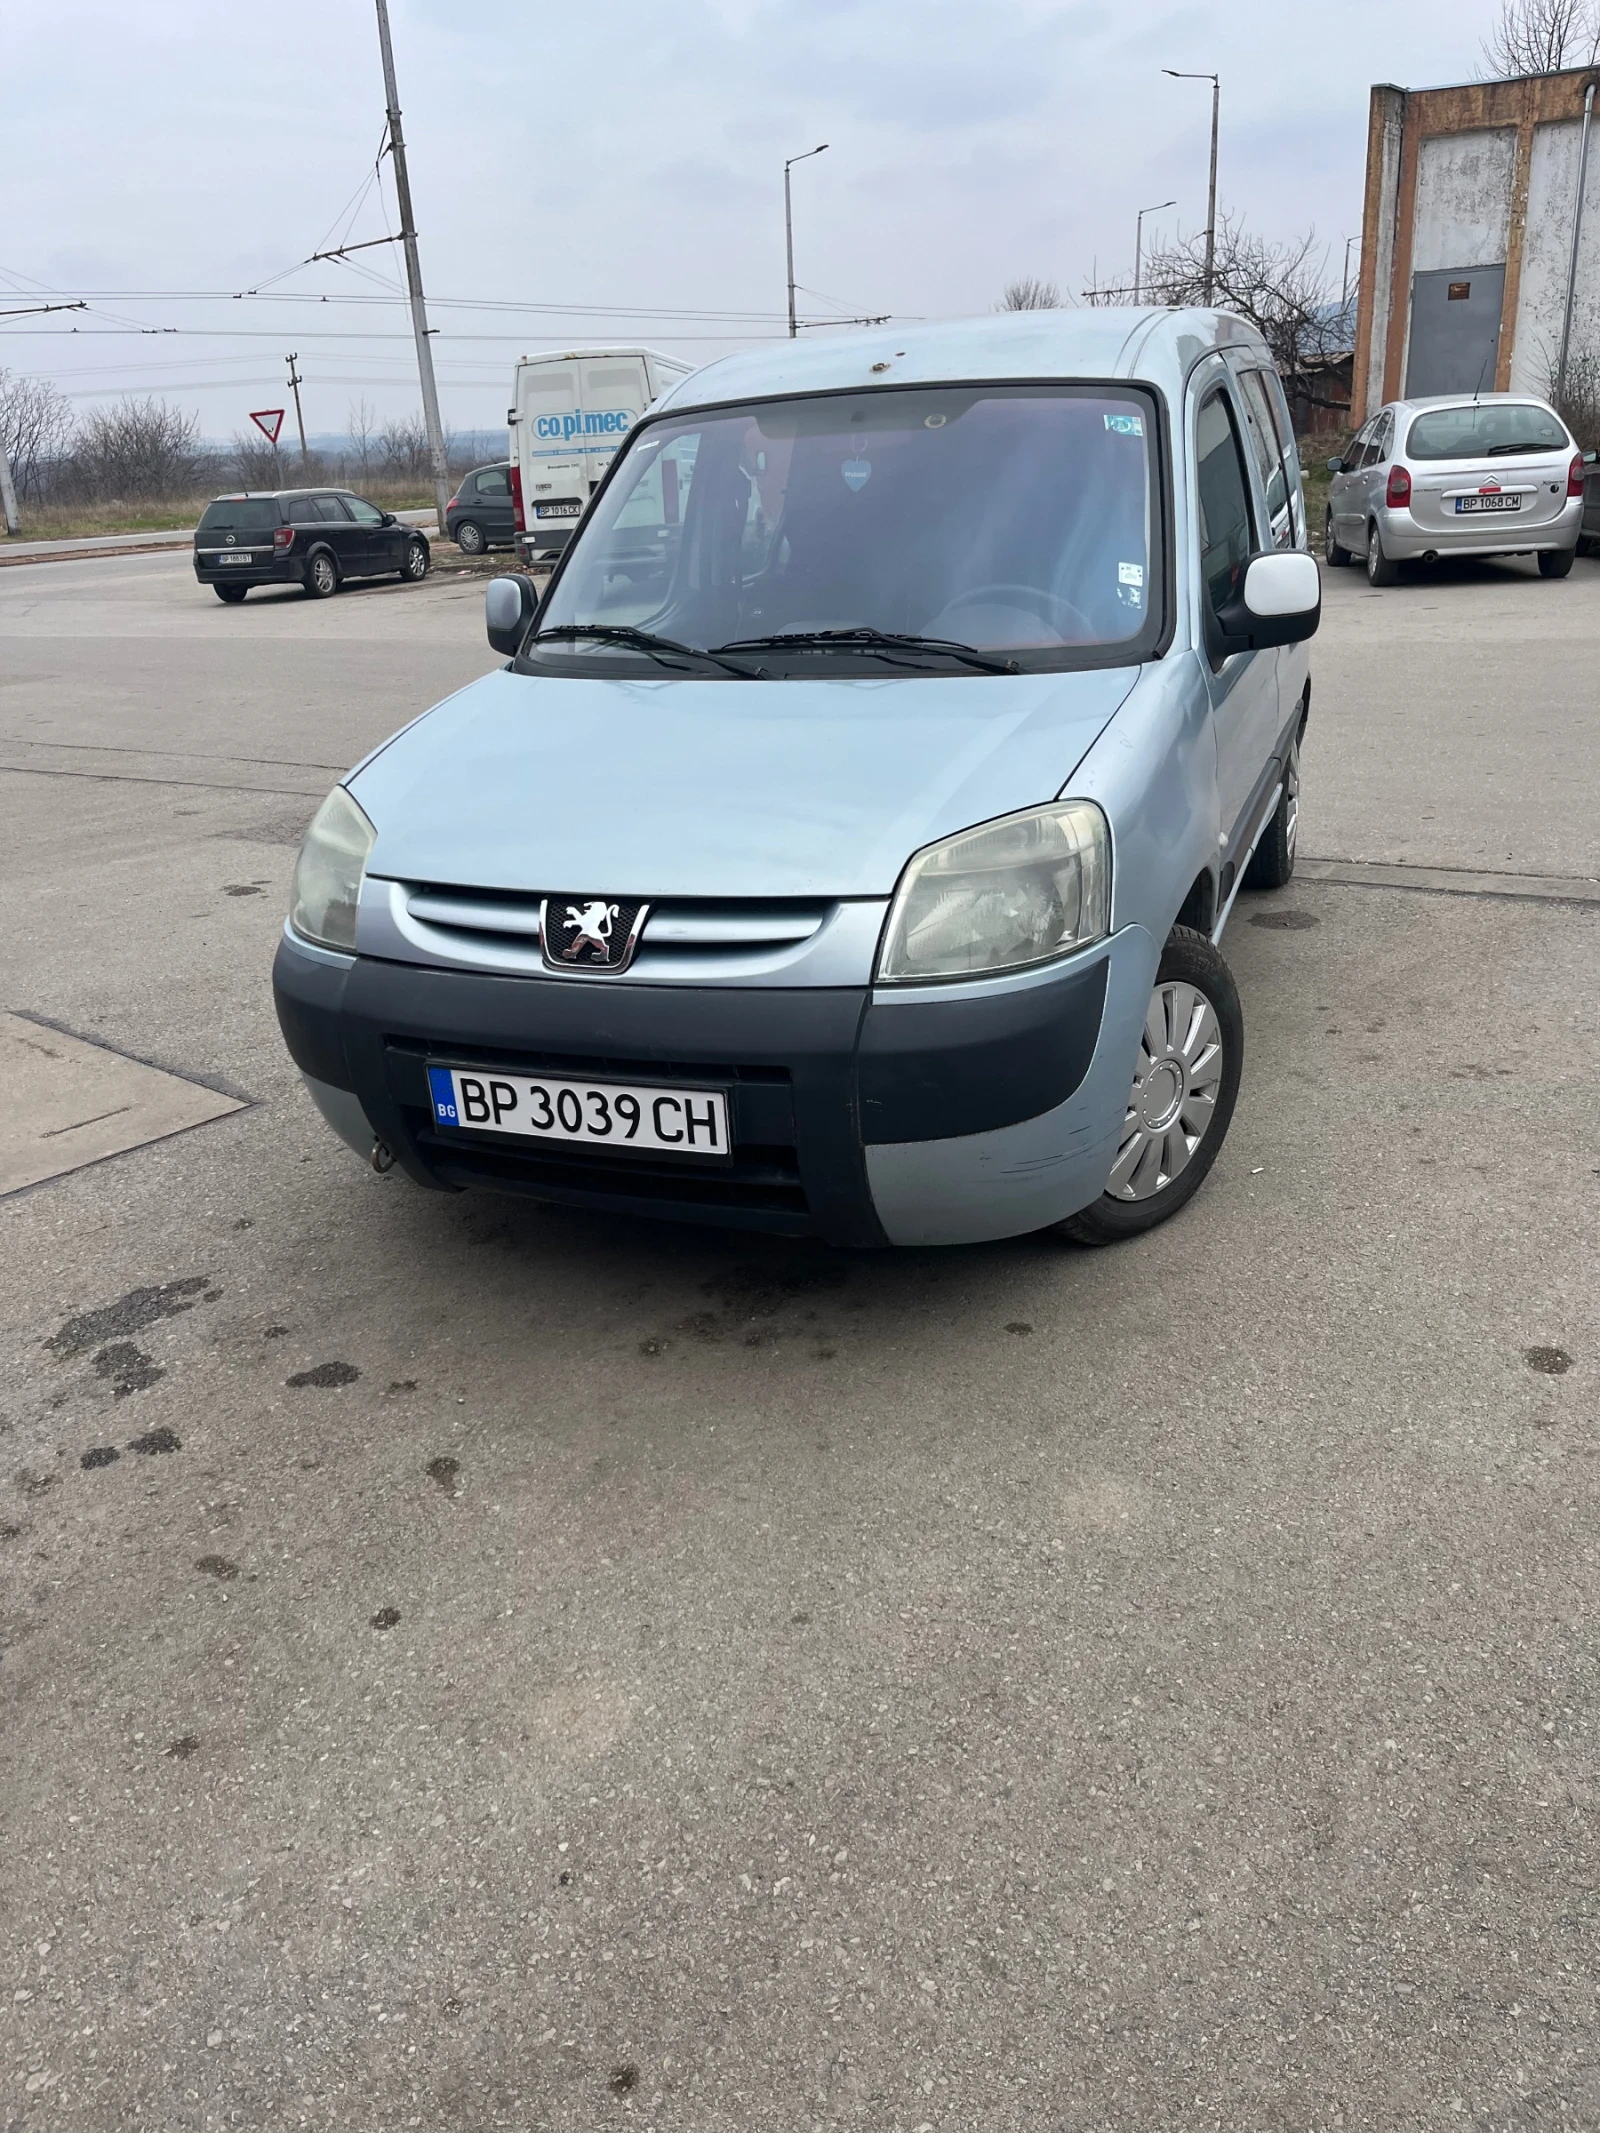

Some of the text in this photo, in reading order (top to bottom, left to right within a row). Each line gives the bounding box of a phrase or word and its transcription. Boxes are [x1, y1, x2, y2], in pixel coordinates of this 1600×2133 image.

[1463, 496, 1519, 509] BP 1068 CM
[540, 506, 549, 515] BP
[551, 505, 567, 514] 1016
[437, 1103, 456, 1117] BG
[460, 1078, 718, 1146] BP 3039 CH
